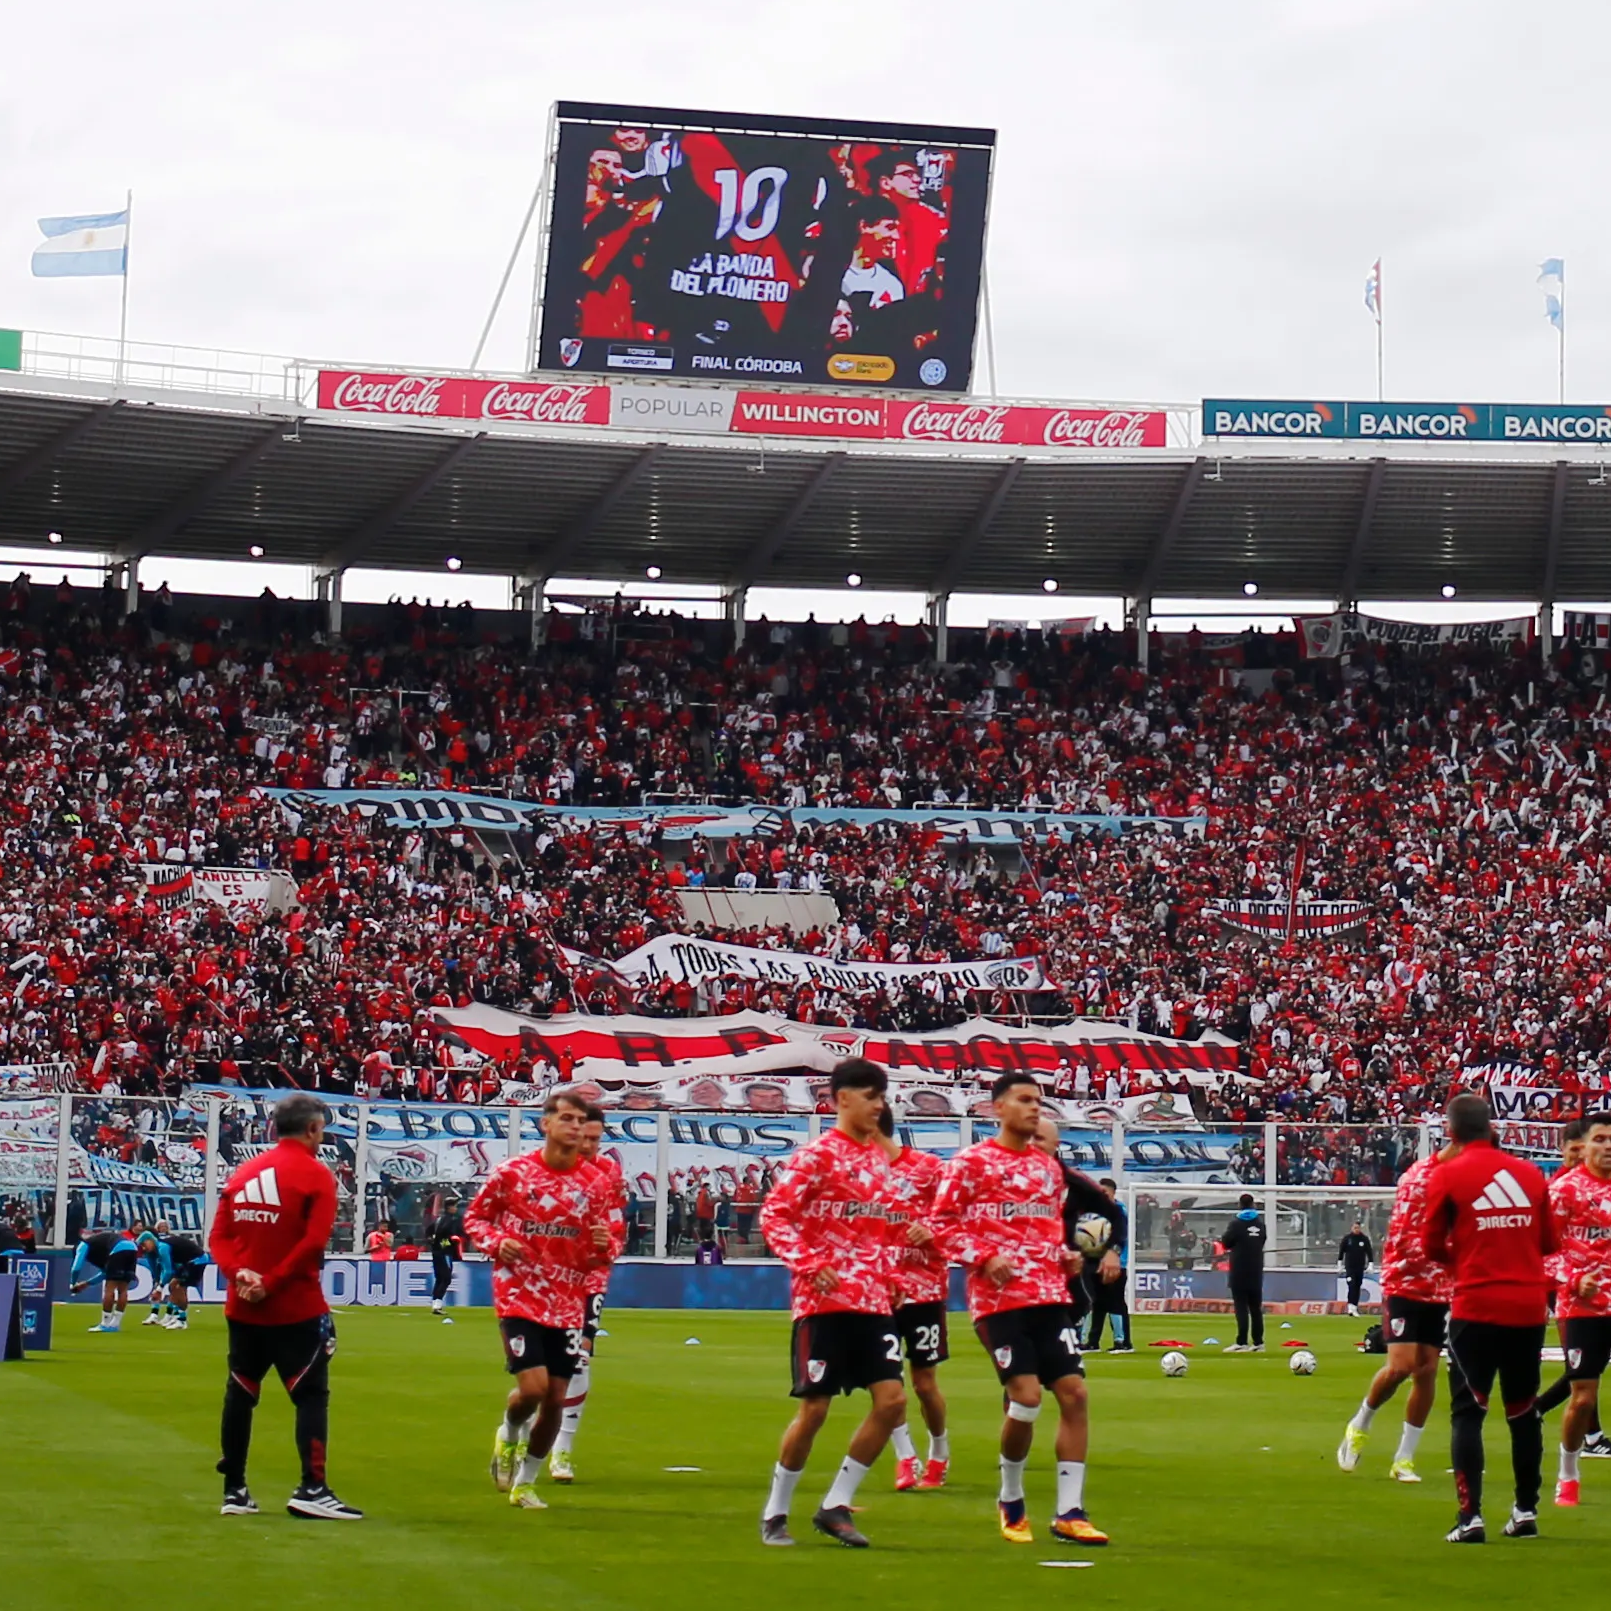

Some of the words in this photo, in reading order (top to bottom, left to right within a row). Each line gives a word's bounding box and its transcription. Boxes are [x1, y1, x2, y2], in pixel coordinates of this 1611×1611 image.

[714, 166, 787, 242] 10
[689, 253, 713, 274] LA
[716, 253, 775, 278] BANDA
[670, 269, 704, 296] DEL
[706, 275, 789, 303] PLOMERO
[691, 355, 732, 371] FINAL
[734, 356, 803, 374] CÓRDOBA
[332, 374, 446, 415] Coca-Cola
[481, 383, 594, 423] Coca-Cola
[620, 397, 724, 417] POPULAR
[741, 402, 880, 427] WILLINGTON
[901, 404, 1009, 443] Coca-Cola
[1214, 410, 1322, 435] BANCOR
[1359, 411, 1467, 437] BANCOR
[1042, 410, 1150, 448] Coca-Cola
[222, 884, 243, 896] ES
[890, 1035, 1238, 1075] ARGENTINA
[233, 1210, 280, 1224] DIRECTV
[1476, 1215, 1532, 1232] DIRECTV
[915, 1323, 941, 1350] 28
